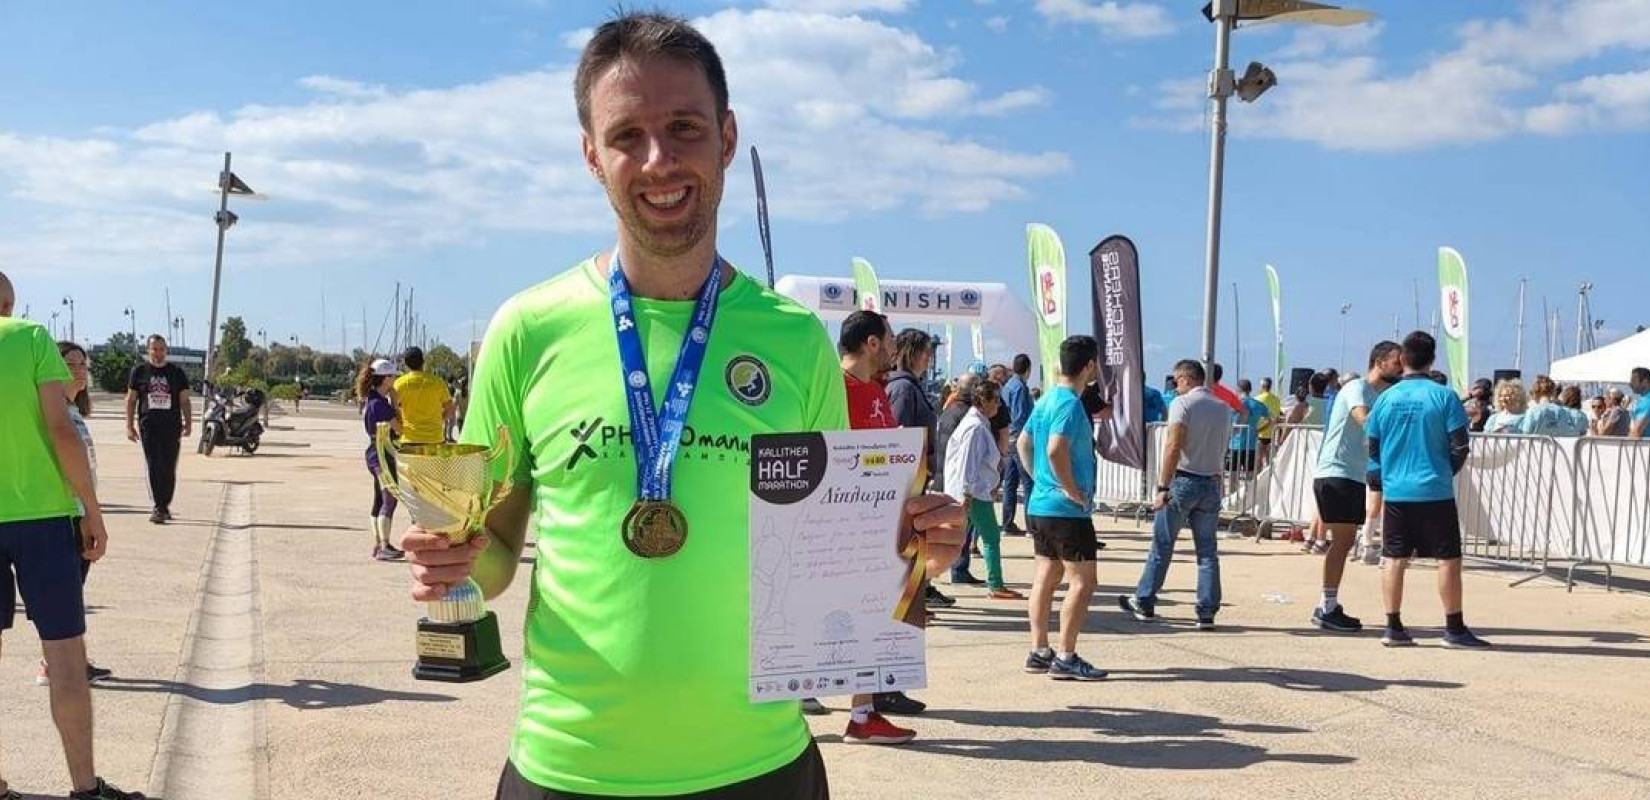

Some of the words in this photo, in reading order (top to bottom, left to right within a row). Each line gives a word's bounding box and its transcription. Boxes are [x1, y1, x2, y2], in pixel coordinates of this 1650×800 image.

[853, 288, 950, 310] NISH
[758, 446, 809, 458] KALLITHEA
[889, 453, 916, 464] ERGO
[758, 459, 809, 480] HALF
[758, 480, 809, 492] MARATHON
